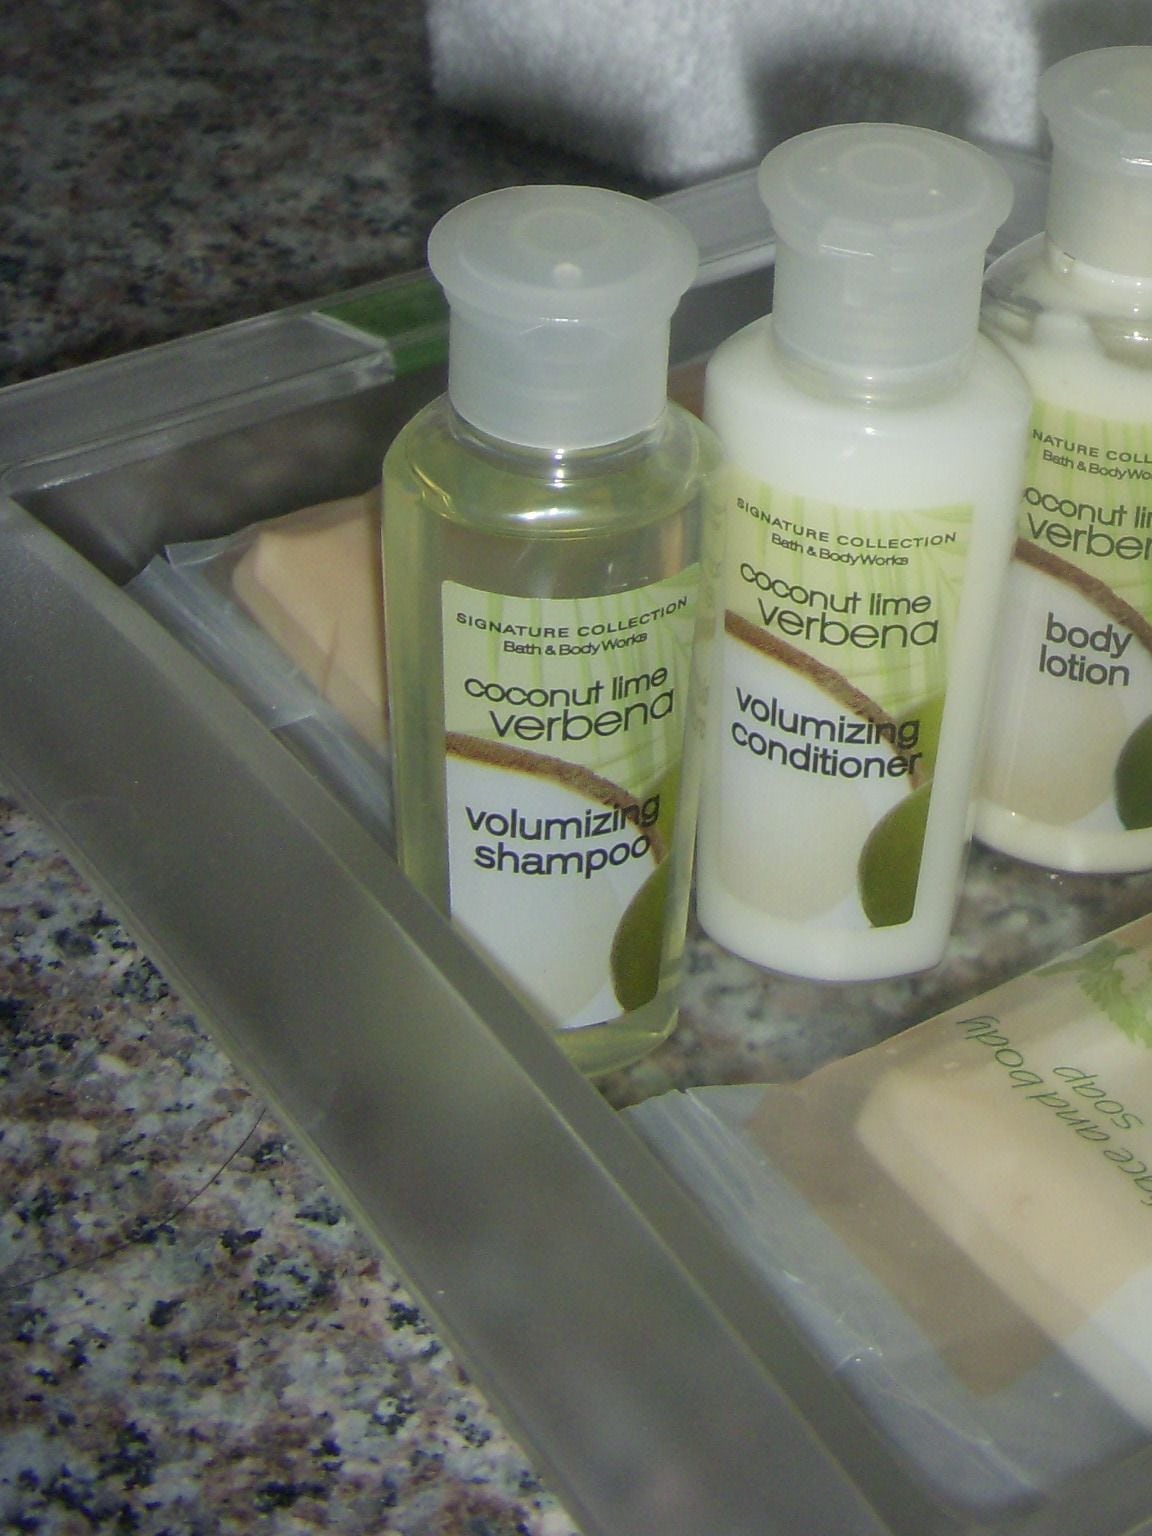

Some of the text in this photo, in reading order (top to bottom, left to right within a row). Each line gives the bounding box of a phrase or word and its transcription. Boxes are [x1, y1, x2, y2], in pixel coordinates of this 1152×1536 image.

[1031, 428, 1100, 458] NATURE
[1042, 448, 1075, 470] Bath
[1076, 460, 1088, 473] &
[1088, 462, 1128, 480] Body
[735, 496, 958, 550] SIGNATURE COLLECTION
[1023, 486, 1128, 527] oconut
[770, 532, 910, 566] Bath & Body Works
[739, 562, 932, 616] coconut lime
[455, 595, 688, 638] SIGNATURE COLLECTION
[757, 596, 939, 650] verbena
[1045, 611, 1134, 660] body
[503, 632, 648, 657] Bath & Body Works
[1038, 643, 1131, 687] lotion
[464, 666, 668, 708] coconut lime
[488, 688, 675, 742] verbena
[734, 685, 921, 750] volumizing
[731, 720, 923, 779] conditioner
[464, 794, 661, 841] volumizing
[473, 835, 651, 880] shampoo
[955, 1014, 1045, 1089] body
[1026, 1090, 1111, 1142] and
[1051, 1064, 1143, 1130] soap
